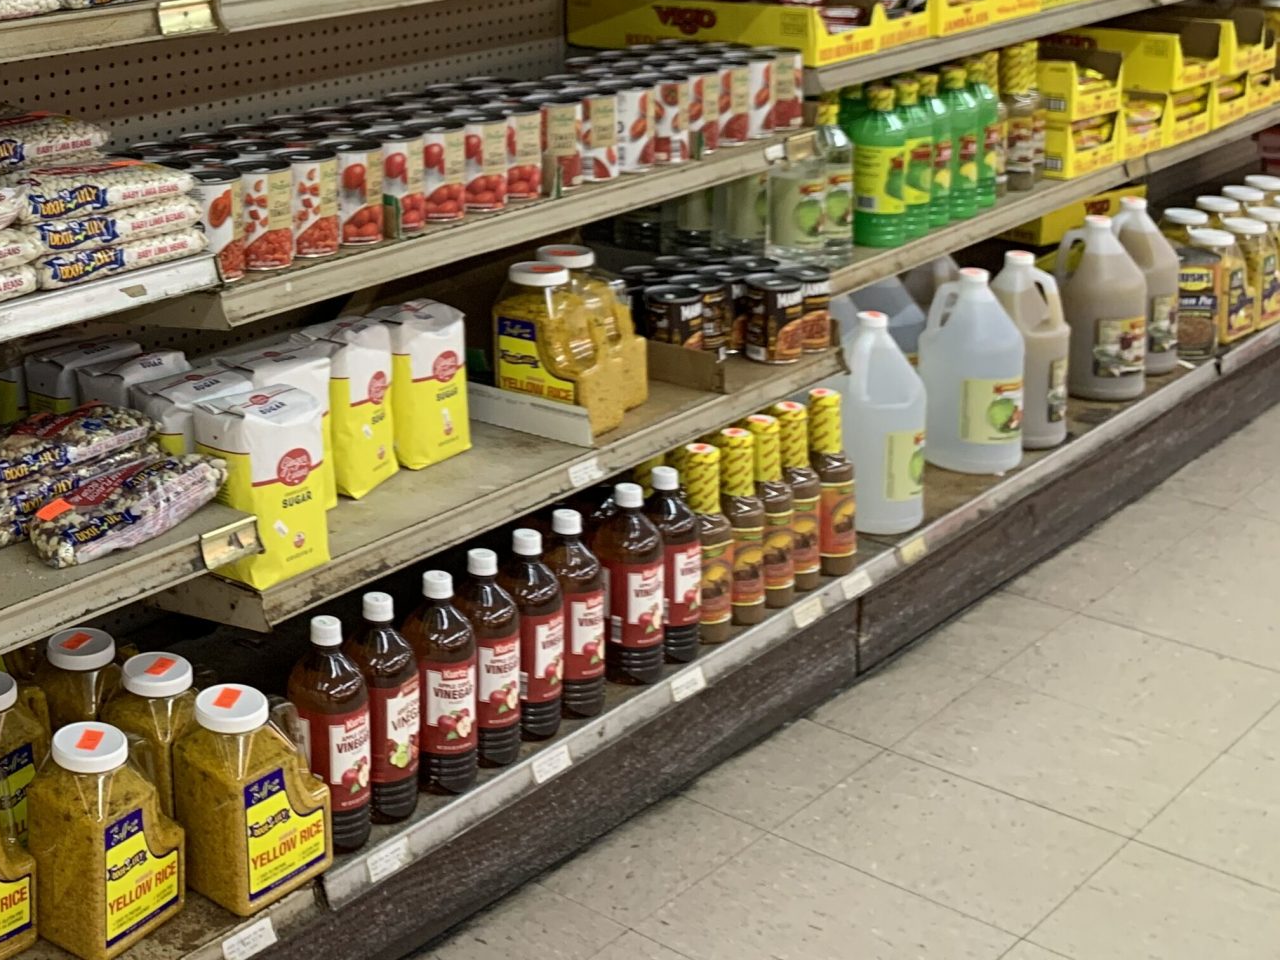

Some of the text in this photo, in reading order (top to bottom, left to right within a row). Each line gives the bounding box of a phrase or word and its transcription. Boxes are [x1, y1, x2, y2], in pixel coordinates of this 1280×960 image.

[0, 247, 21, 261] BEANS
[282, 491, 312, 508] SUGAR
[252, 819, 324, 870] YELLOW RICE
[154, 860, 177, 885] RICE
